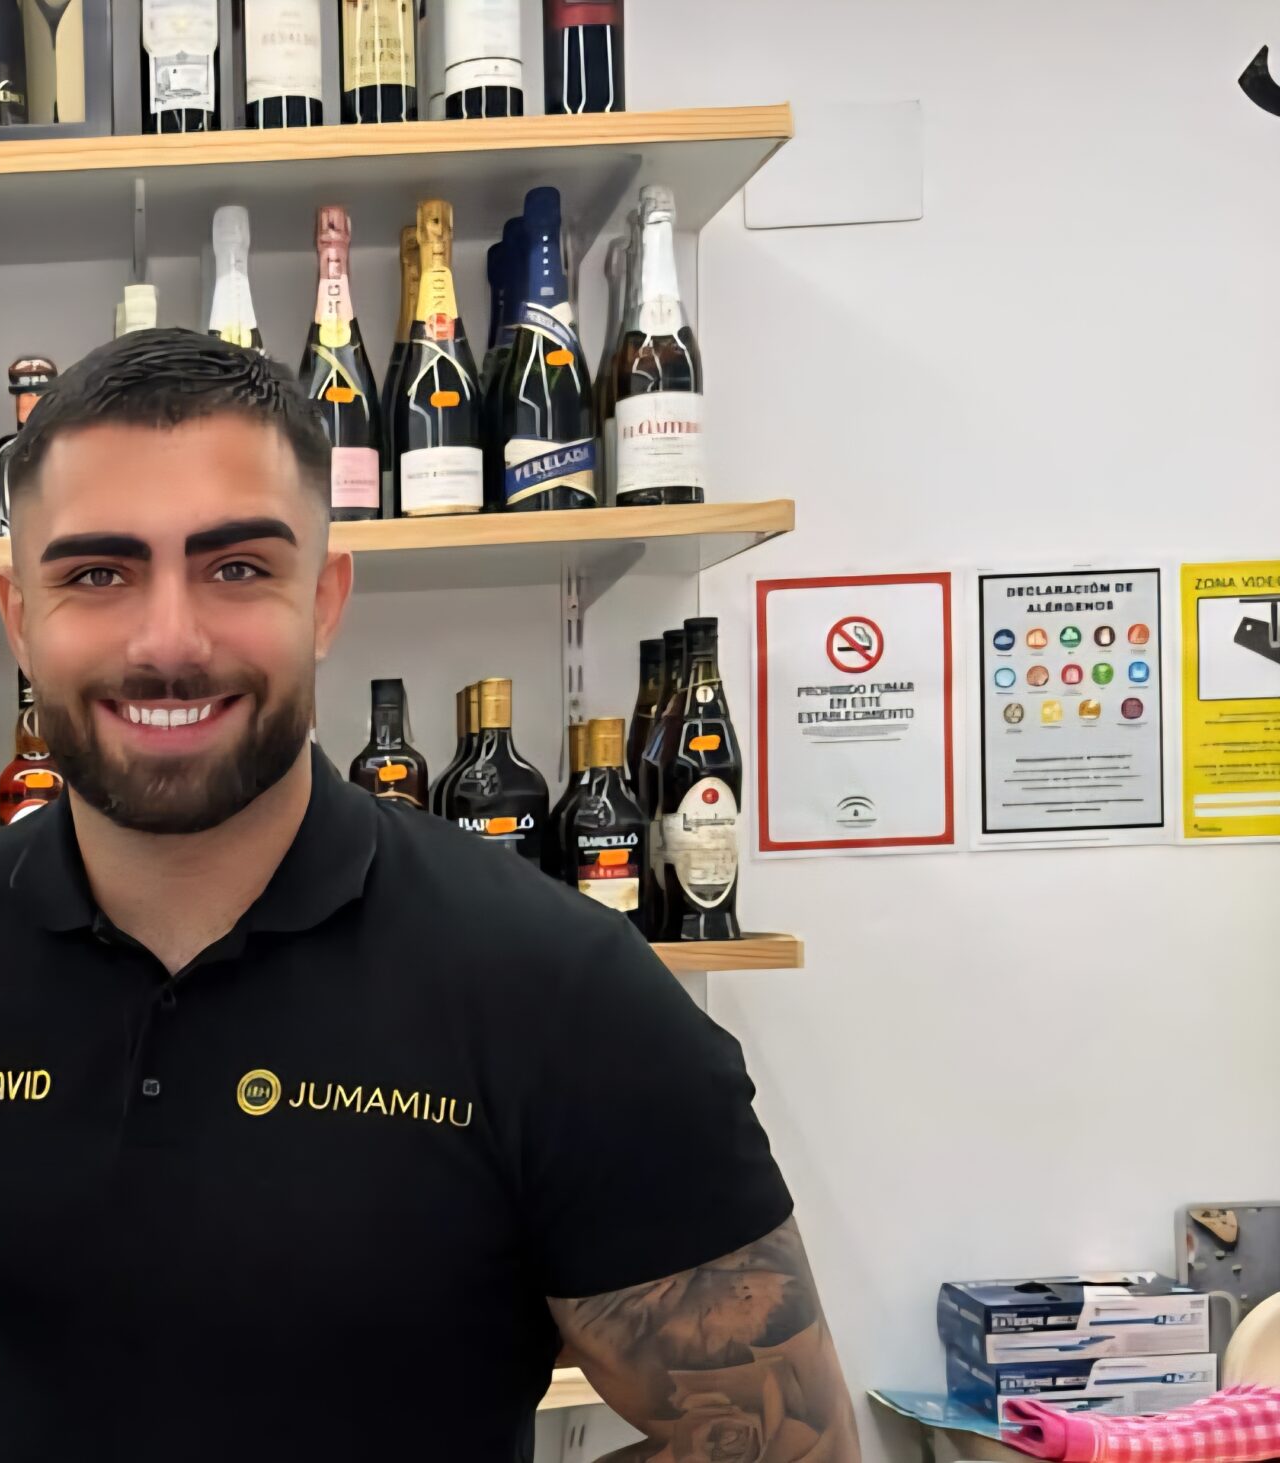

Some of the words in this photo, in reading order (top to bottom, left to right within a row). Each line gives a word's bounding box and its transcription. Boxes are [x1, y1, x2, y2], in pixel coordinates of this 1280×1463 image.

[1114, 582, 1133, 593] DE
[1195, 577, 1236, 590] ZONA
[288, 1080, 474, 1128] JUMAMIJU
